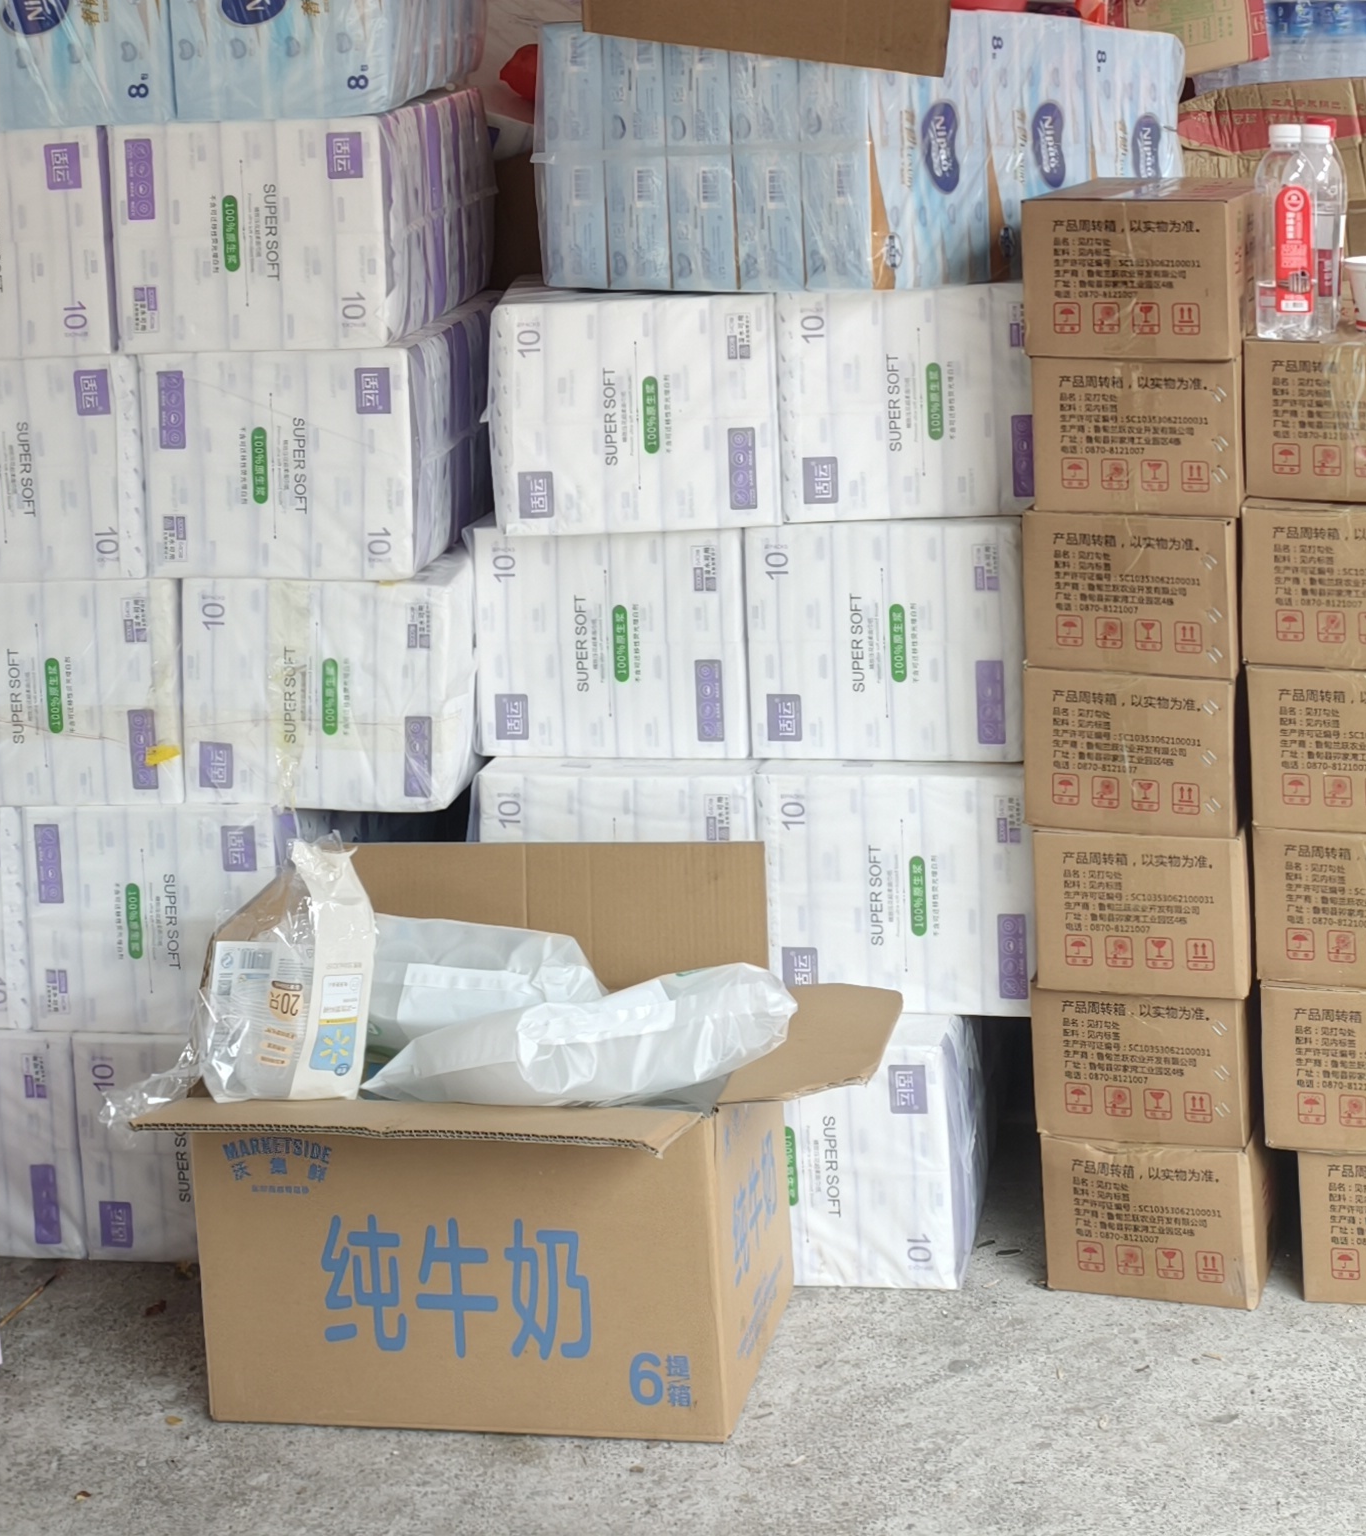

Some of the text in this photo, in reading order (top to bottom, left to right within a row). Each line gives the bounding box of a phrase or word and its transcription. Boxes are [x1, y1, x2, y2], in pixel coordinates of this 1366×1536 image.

[128, 84, 150, 99] 8
[347, 73, 371, 92] 8
[934, 113, 951, 180] Nipao
[1042, 115, 1059, 181] Nipao
[225, 202, 238, 264] 100%原生浆
[263, 183, 280, 281] SUPER SOFT
[63, 300, 88, 330] 10
[341, 291, 367, 321] 10
[517, 328, 541, 358] 10
[602, 367, 619, 467] SUPER SOFT
[645, 384, 658, 448] 100%原生浆
[17, 420, 36, 516] SUPER SOFT
[254, 433, 267, 498] 100%原生浆
[292, 416, 308, 515] SUPER SOFT
[367, 525, 392, 556] 10
[764, 550, 789, 581] 10
[573, 594, 590, 693] SUPER SOFT
[614, 611, 628, 675] 100%原生浆
[848, 592, 866, 693] SUPER SOFT
[891, 610, 905, 676] 100%原生浆
[7, 648, 26, 744] SUPER SOFT
[46, 664, 62, 729] 100%原生浆
[780, 801, 805, 832] 10
[868, 845, 885, 946] SUPER SOFT
[912, 863, 926, 930] 100%原生浆
[222, 1137, 333, 1163] MARKETSIDE
[822, 1115, 842, 1219] SUPER SOFT
[906, 1233, 932, 1265] 10
[321, 1214, 592, 1361] 纯牛奶
[629, 1352, 664, 1406] 6
